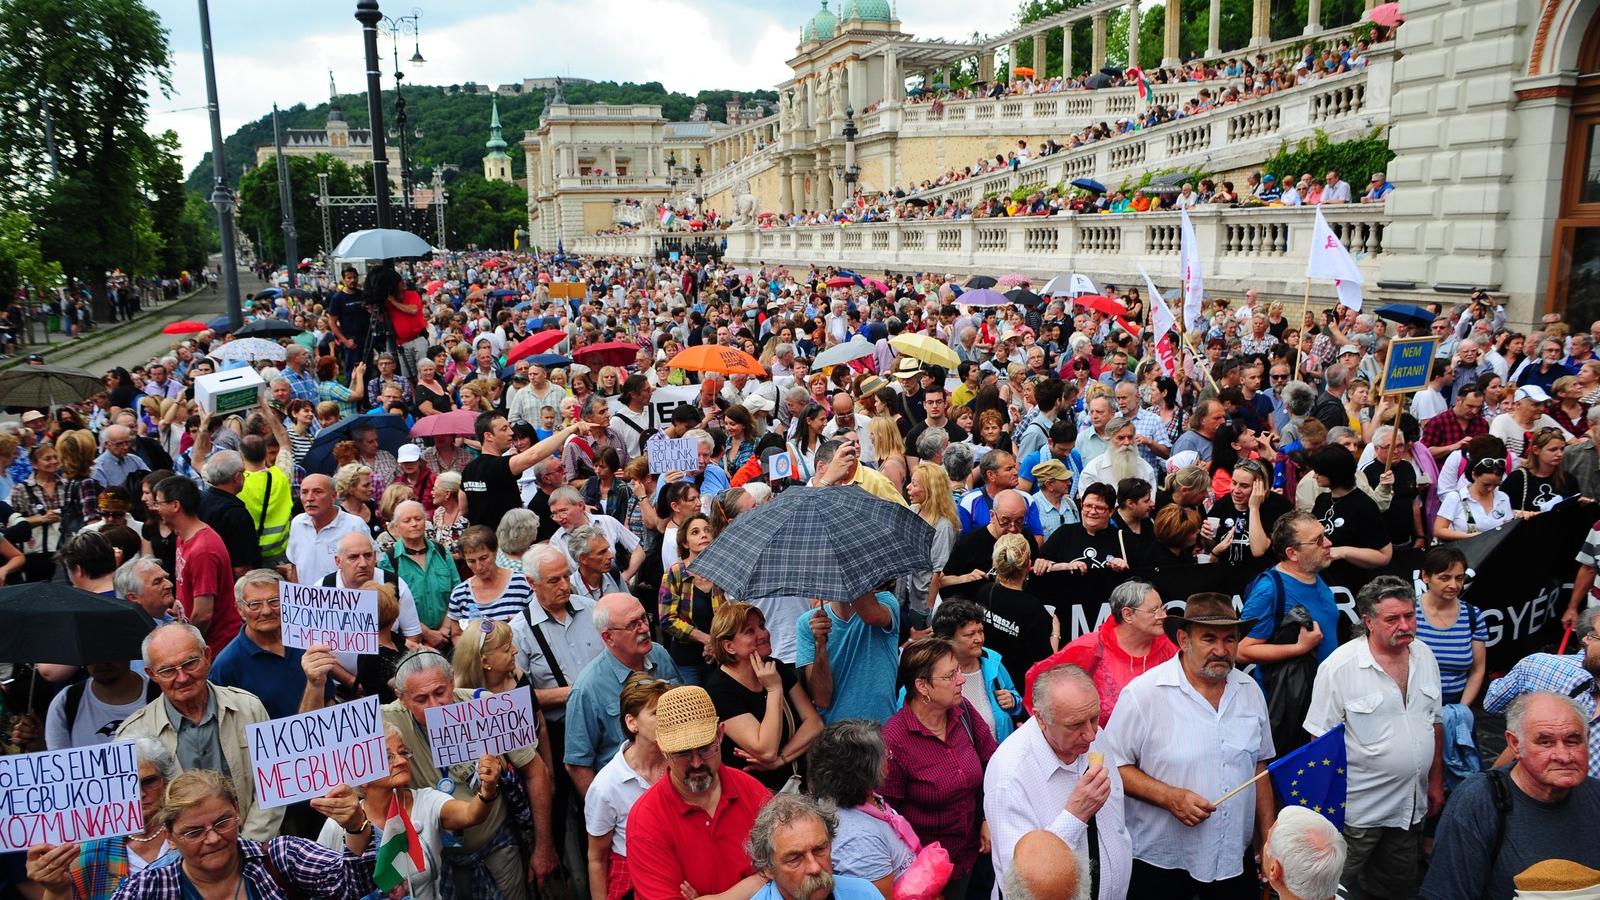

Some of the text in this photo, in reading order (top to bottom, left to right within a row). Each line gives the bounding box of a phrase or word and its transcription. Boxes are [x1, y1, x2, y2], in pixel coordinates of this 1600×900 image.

[1402, 346, 1422, 358] NEM
[1391, 364, 1425, 378] ÁRTANI!
[652, 439, 690, 452] SEMMIT
[283, 584, 361, 611] A KORMÁNY
[441, 693, 513, 725] NINCS
[255, 698, 378, 761] A KORMÁNY
[429, 707, 529, 747] HATALMATOK
[437, 725, 536, 766] FELETTÜNK!
[14, 754, 66, 787] ÉVES
[256, 735, 386, 802] MEGBUKOTT
